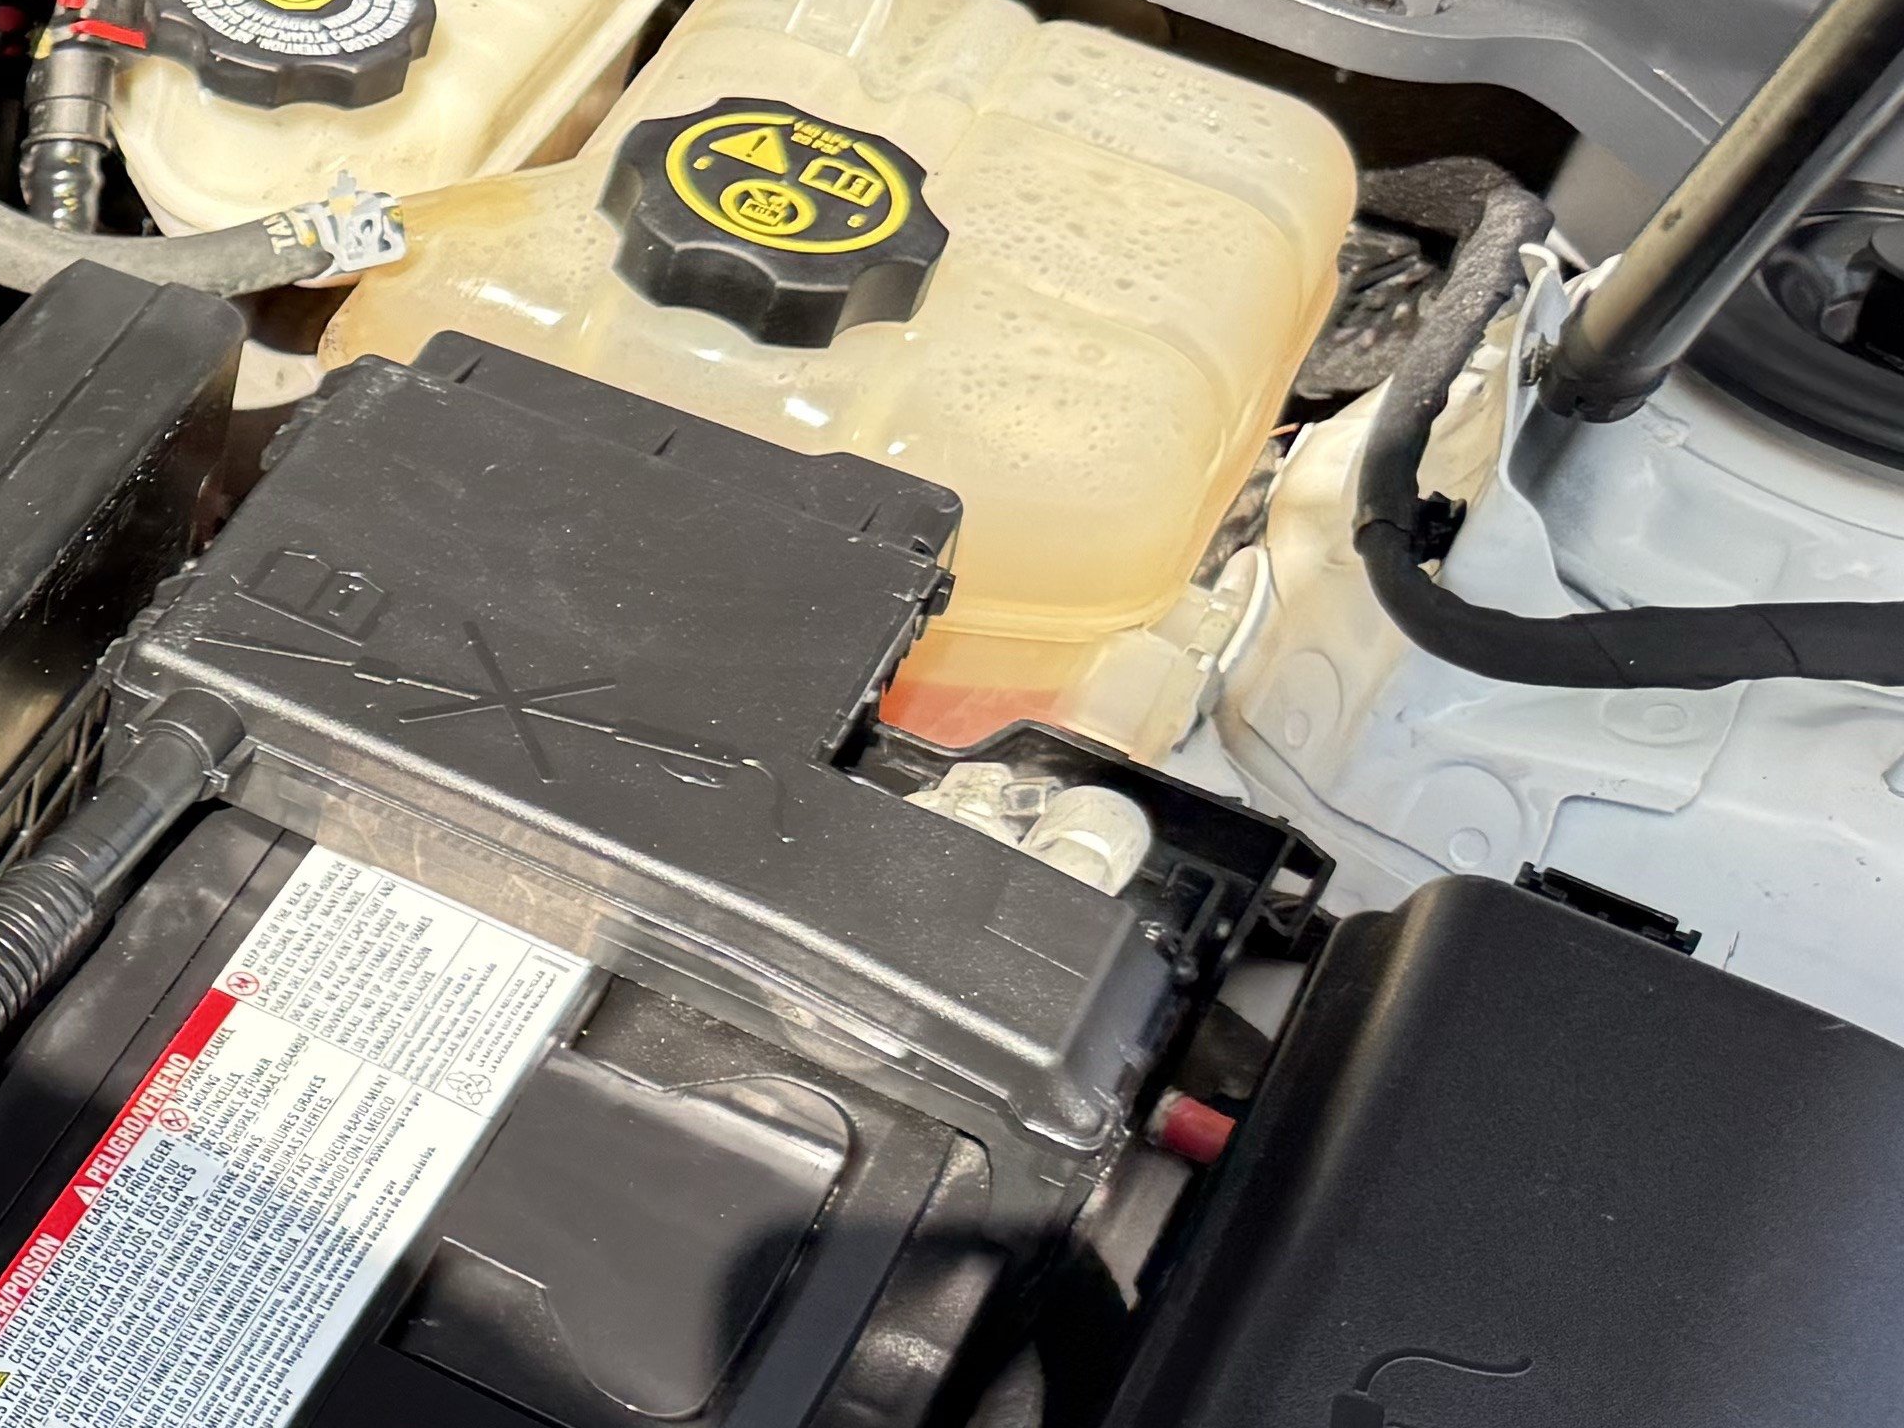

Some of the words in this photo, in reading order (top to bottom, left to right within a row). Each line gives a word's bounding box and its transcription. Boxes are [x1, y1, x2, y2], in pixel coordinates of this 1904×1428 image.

[83, 1050, 193, 1185] PELIGRO/VENENO
[231, 1180, 252, 1200] OU
[241, 1160, 266, 1184] DES
[247, 1135, 304, 1207] QUEMADURAS
[19, 1283, 50, 1316] EYES
[40, 1223, 93, 1286] EXPLOSIVE
[83, 1185, 121, 1226] GASES
[110, 1163, 137, 1188] CAN
[197, 1230, 217, 1248] LA
[209, 1212, 251, 1262] CEGUERA
[241, 1203, 257, 1216] O
[6, 1327, 41, 1364] CAUSE
[31, 1269, 82, 1330] BLINDNESS
[72, 1254, 92, 1273] OR
[114, 1195, 135, 1213] SE
[21, 1346, 47, 1372] LES
[37, 1320, 65, 1349] GAZ
[55, 1260, 108, 1324] EXPLOSIFS
[98, 1215, 140, 1264] PEUVENT
[130, 1172, 171, 1219] BLESSER
[160, 1157, 181, 1176] OU
[67, 1281, 114, 1336] PROTEJA
[104, 1257, 131, 1284] LOS
[145, 1201, 171, 1227] LOS
[161, 1163, 198, 1204] GASES
[169, 1244, 208, 1288] CAUSER
[169, 1396, 192, 1419] LOS
[183, 1369, 211, 1399] OJOS
[201, 1284, 268, 1372] INMEDIATAMENTE
[259, 1263, 283, 1287] CON
[295, 1198, 327, 1234] ACUDA
[341, 1143, 364, 1166] CON
[355, 1132, 372, 1145] EL
[180, 1258, 219, 1304] CAUSAR
[53, 1363, 103, 1423] SULFURIC
[93, 1333, 124, 1366] ACID
[114, 1310, 140, 1336] CAN
[130, 1275, 165, 1313] CAUSE
[154, 1219, 204, 1279] BLINDNESS
[193, 1203, 215, 1222] OR
[204, 1167, 240, 1207] SEVERE
[64, 1325, 104, 1371] PUEDEN
[93, 1283, 134, 1328] CAUSAR
[148, 1237, 166, 1250] O
[129, 1385, 156, 1414] EYES
[146, 1320, 200, 1388] IMMEDIATELY
[190, 1294, 218, 1324] WITH
[233, 1240, 256, 1262] GET
[246, 1198, 284, 1243] MEDICAL
[274, 1175, 300, 1201] HELP
[151, 1284, 180, 1315] PEUT
[156, 1384, 179, 1406] LES
[169, 1357, 197, 1387] YEUX
[267, 1187, 313, 1243] CONSULTER
[303, 1172, 323, 1190] UN
[157, 1300, 190, 1337] PUEDE
[102, 1311, 161, 1385] SULFURIQUE
